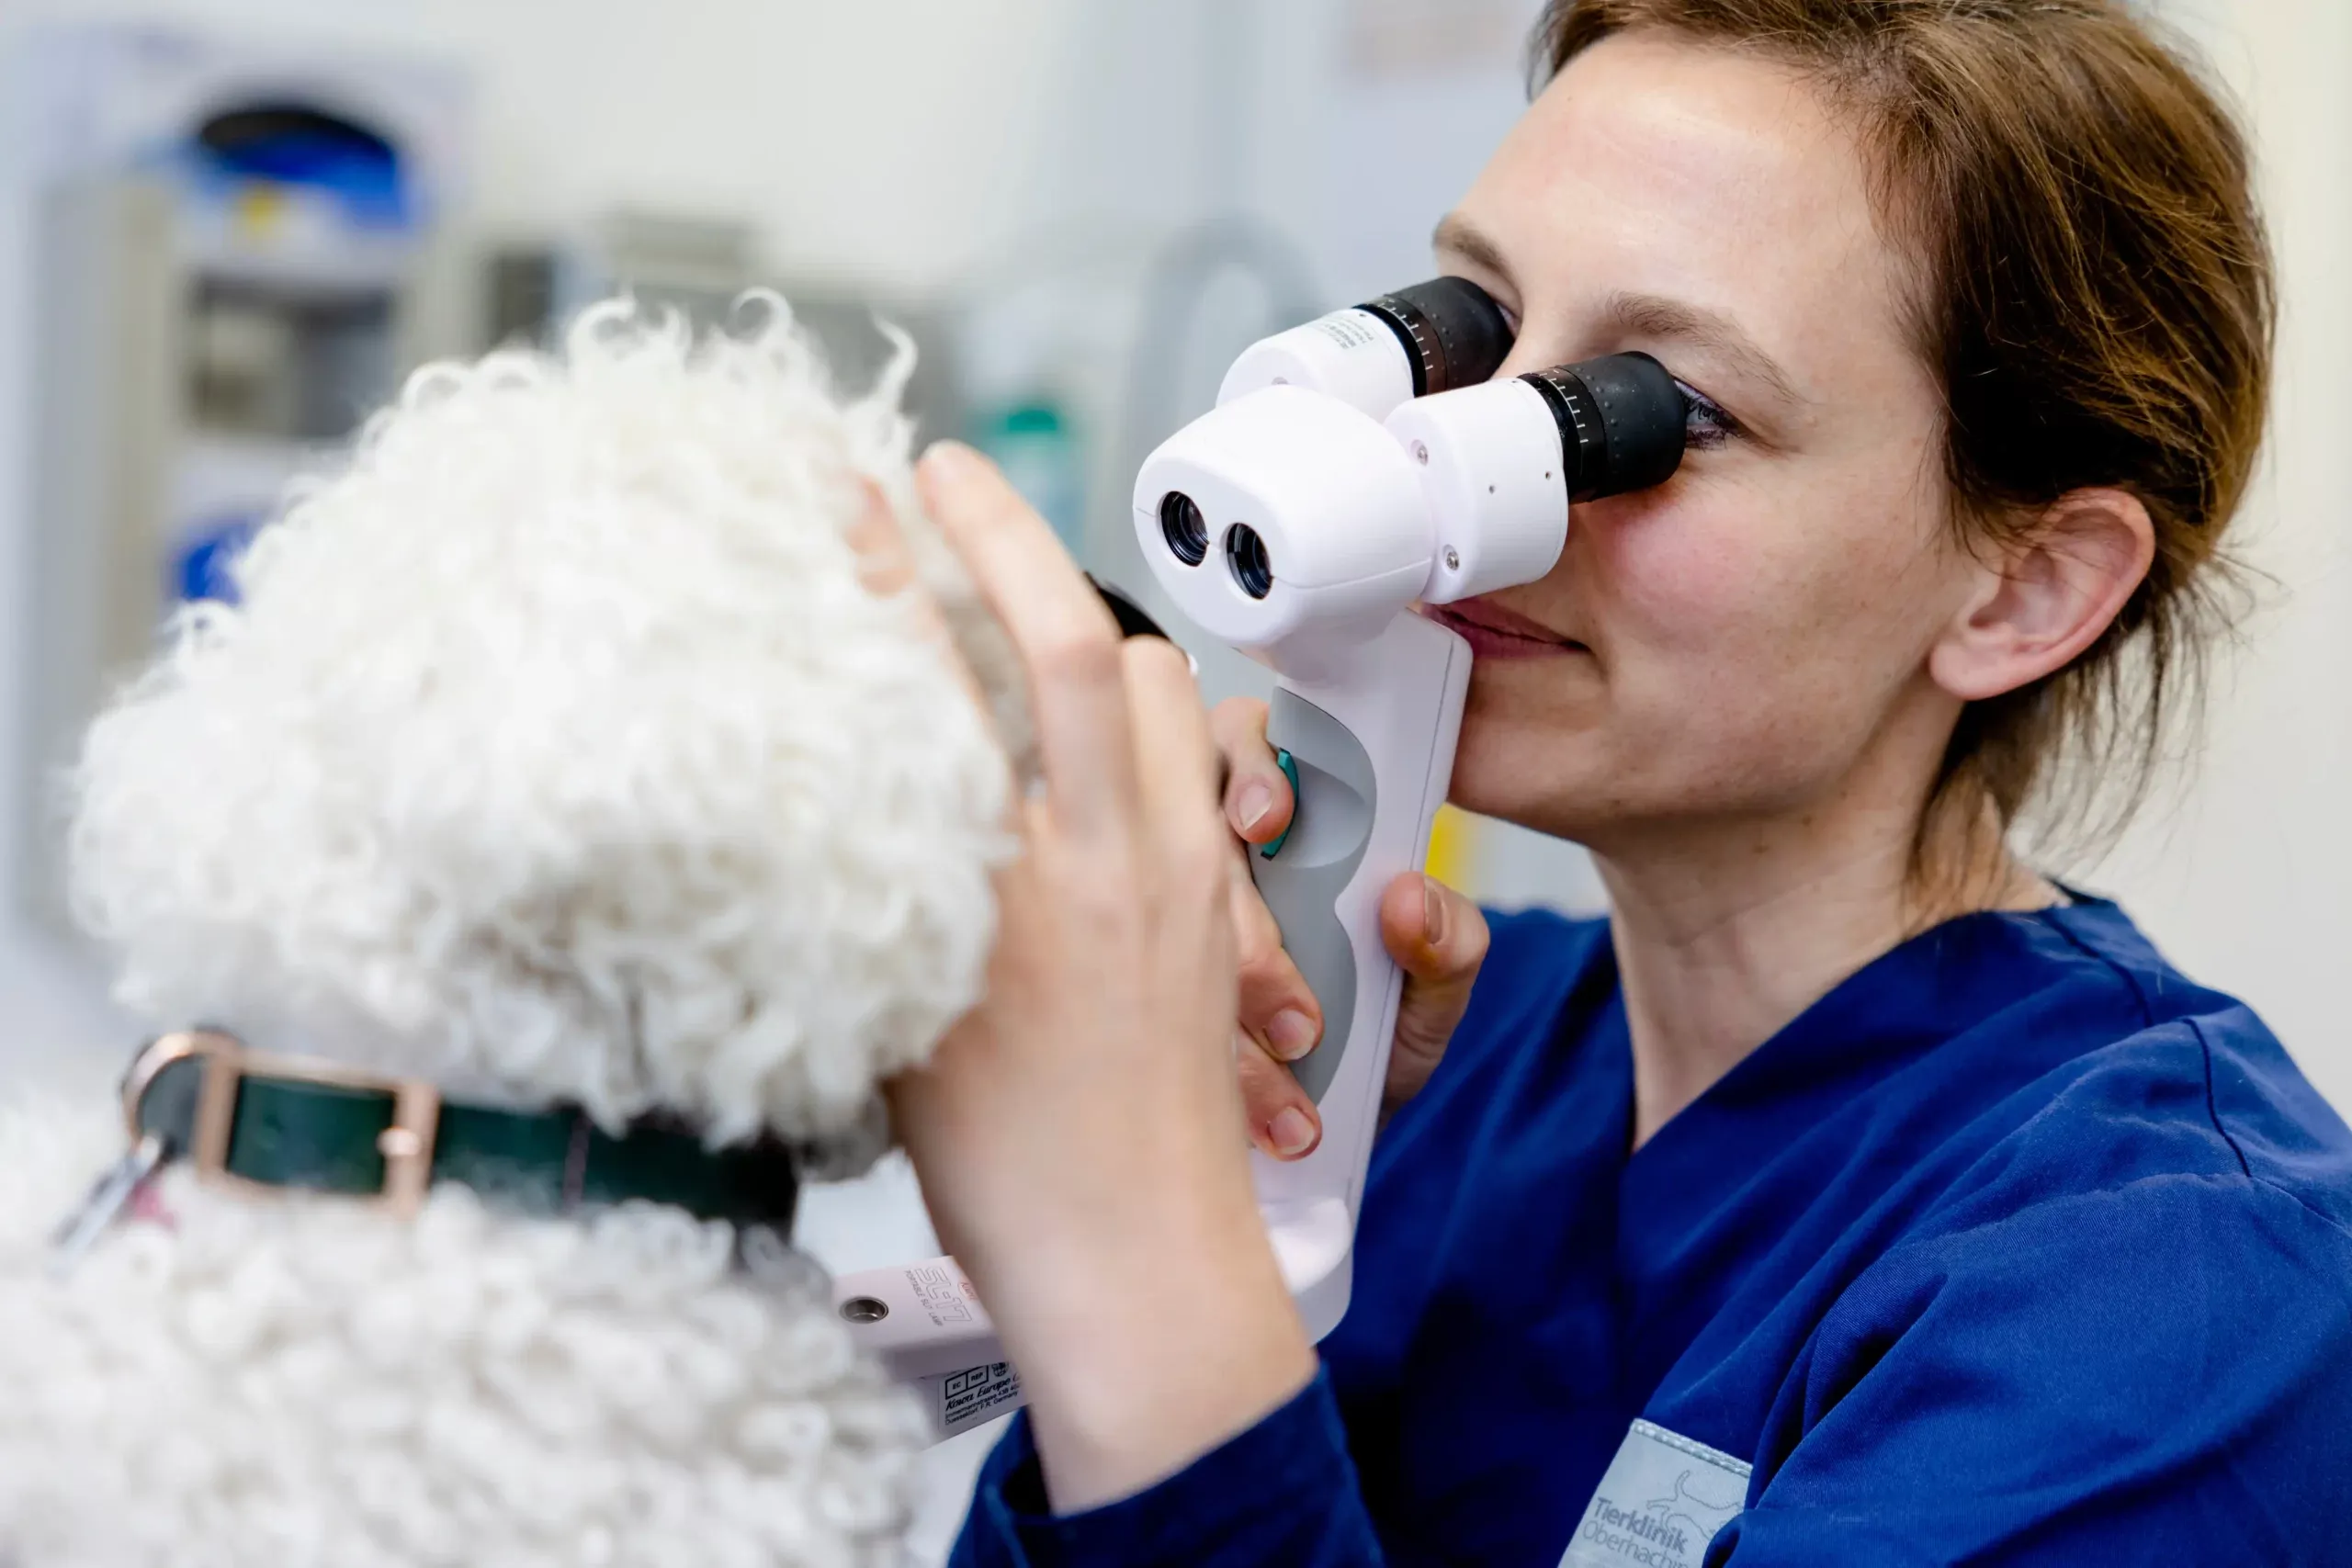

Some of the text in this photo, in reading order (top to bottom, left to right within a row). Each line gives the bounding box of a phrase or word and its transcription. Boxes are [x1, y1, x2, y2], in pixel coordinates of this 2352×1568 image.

[904, 1269, 926, 1298] PORTABLE
[928, 1312, 944, 1327] LAMP
[914, 1267, 973, 1322] SL-17
[945, 1393, 974, 1411] Kowa
[977, 1377, 1011, 1397] Europe
[952, 1371, 984, 1390] EC REP
[993, 1390, 1018, 1404] Germany
[1594, 1496, 1689, 1555] Tierklinik
